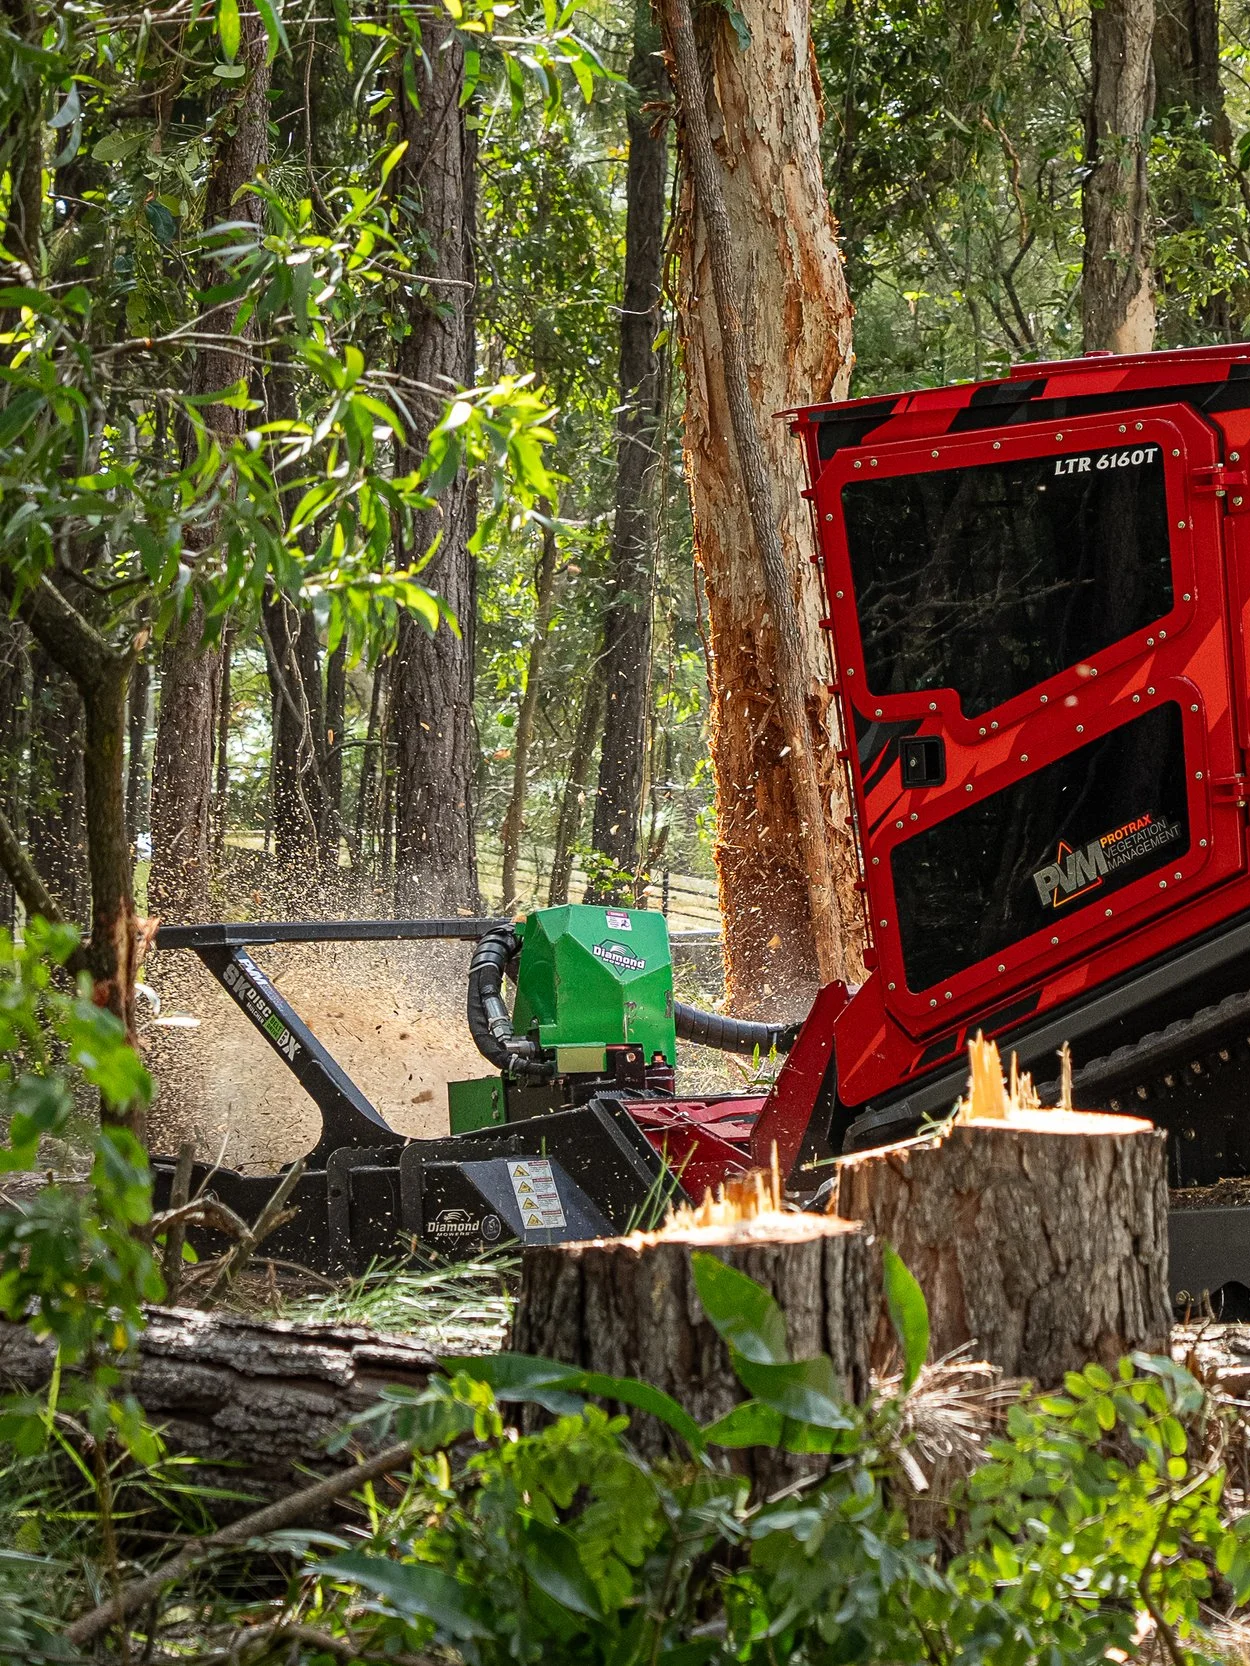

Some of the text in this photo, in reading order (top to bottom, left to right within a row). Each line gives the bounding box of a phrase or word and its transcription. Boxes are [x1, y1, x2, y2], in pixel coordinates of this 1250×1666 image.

[1054, 448, 1158, 475] LTR 6160T
[1100, 814, 1152, 848] PROTRAX
[1103, 819, 1167, 859] VEGETATION
[1108, 825, 1180, 871] MANAGEMENT
[1033, 840, 1109, 906] PVM
[593, 945, 646, 969] Diamond
[223, 963, 252, 1000] SK
[247, 988, 272, 1018] DISC
[427, 1221, 480, 1233] Diamond
